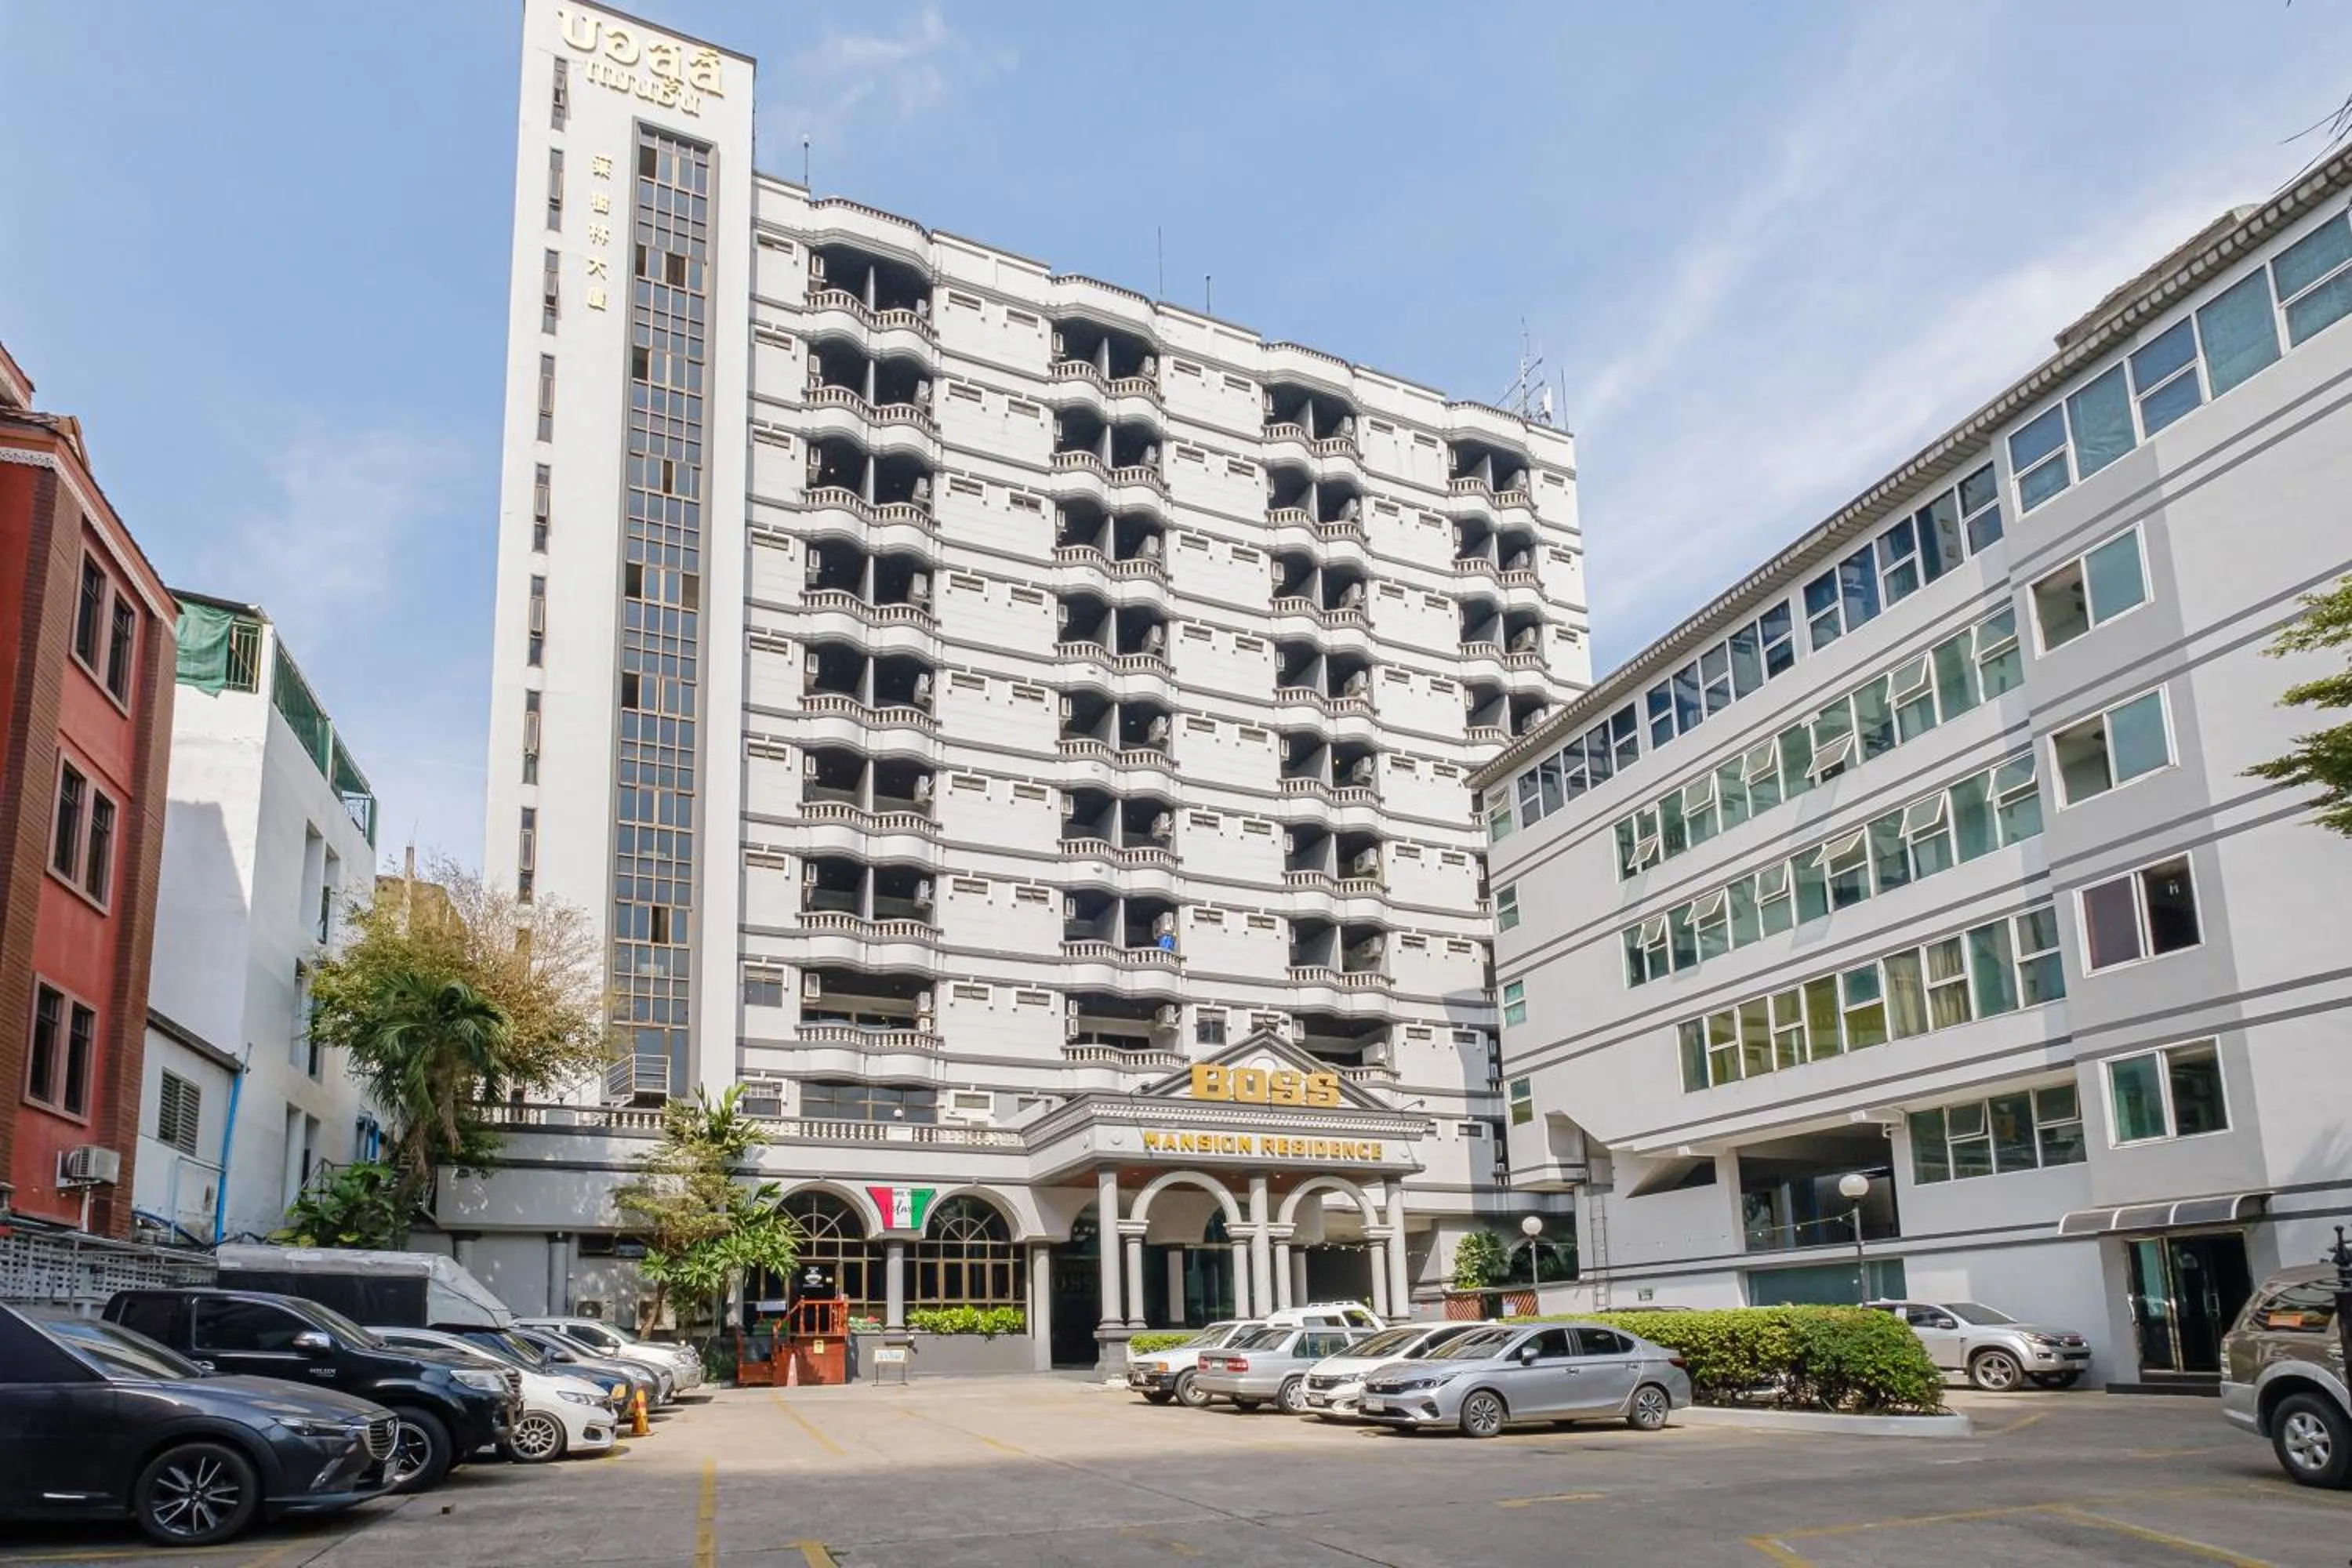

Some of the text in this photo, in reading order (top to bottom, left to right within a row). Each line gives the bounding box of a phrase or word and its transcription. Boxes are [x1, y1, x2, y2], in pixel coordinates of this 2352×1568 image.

[1191, 1064, 1341, 1108] BOSS
[1143, 1130, 1382, 1161] MANSION RESIDENCE
